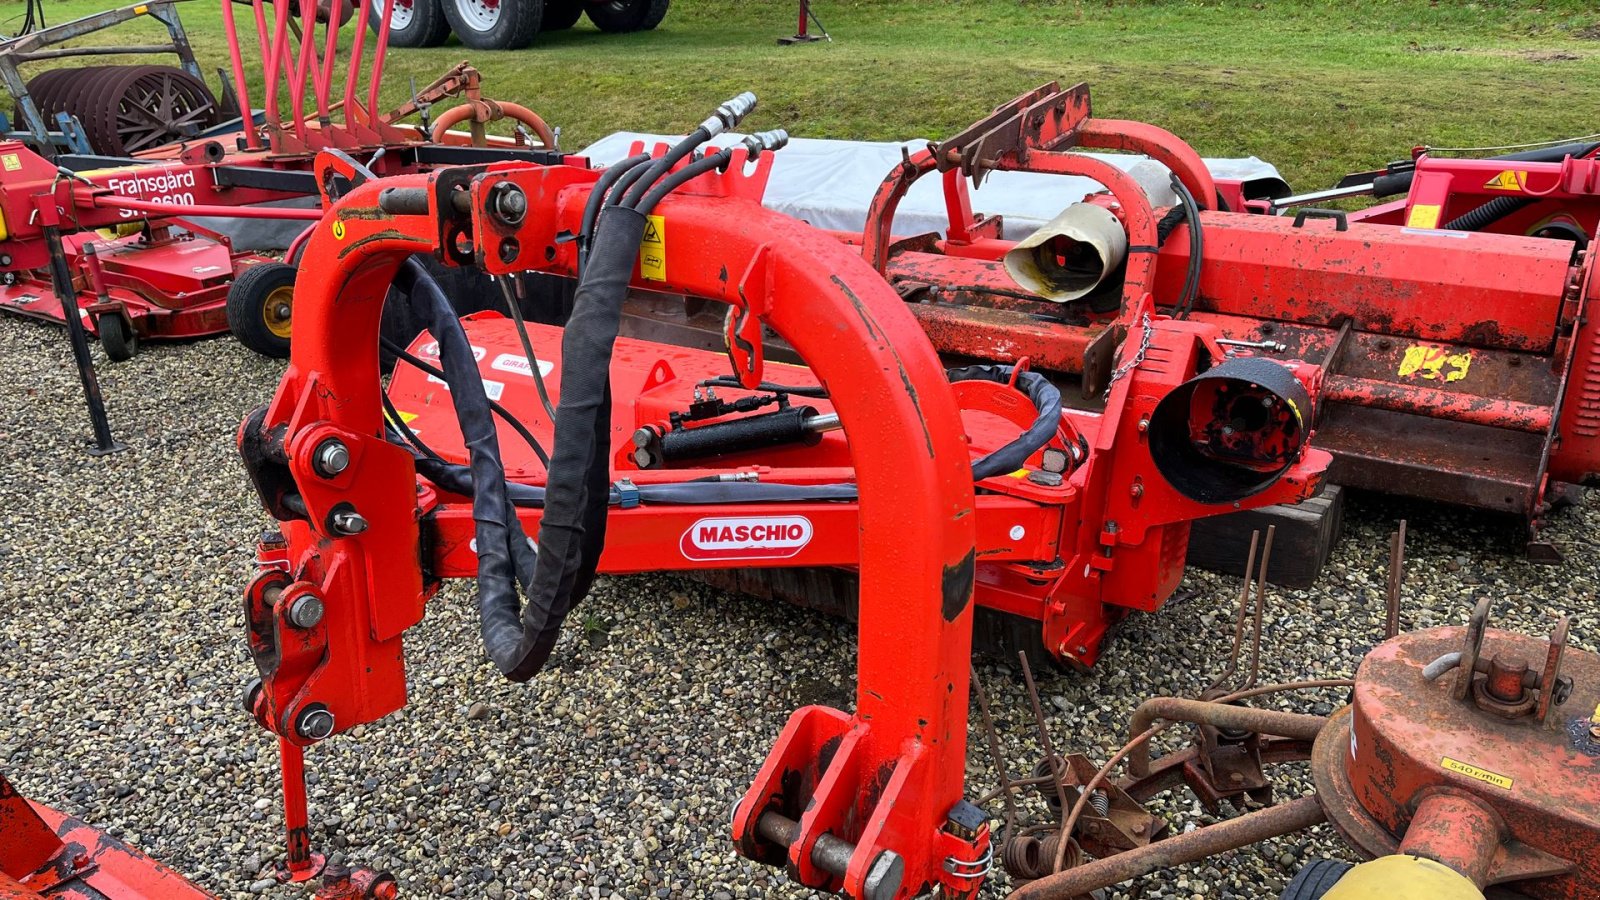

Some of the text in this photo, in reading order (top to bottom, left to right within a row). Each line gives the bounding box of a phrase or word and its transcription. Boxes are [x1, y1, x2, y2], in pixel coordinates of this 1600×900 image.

[109, 170, 195, 195] Fransgård
[699, 524, 804, 543] MASCHIO
[1450, 762, 1503, 784] 540 r/min
